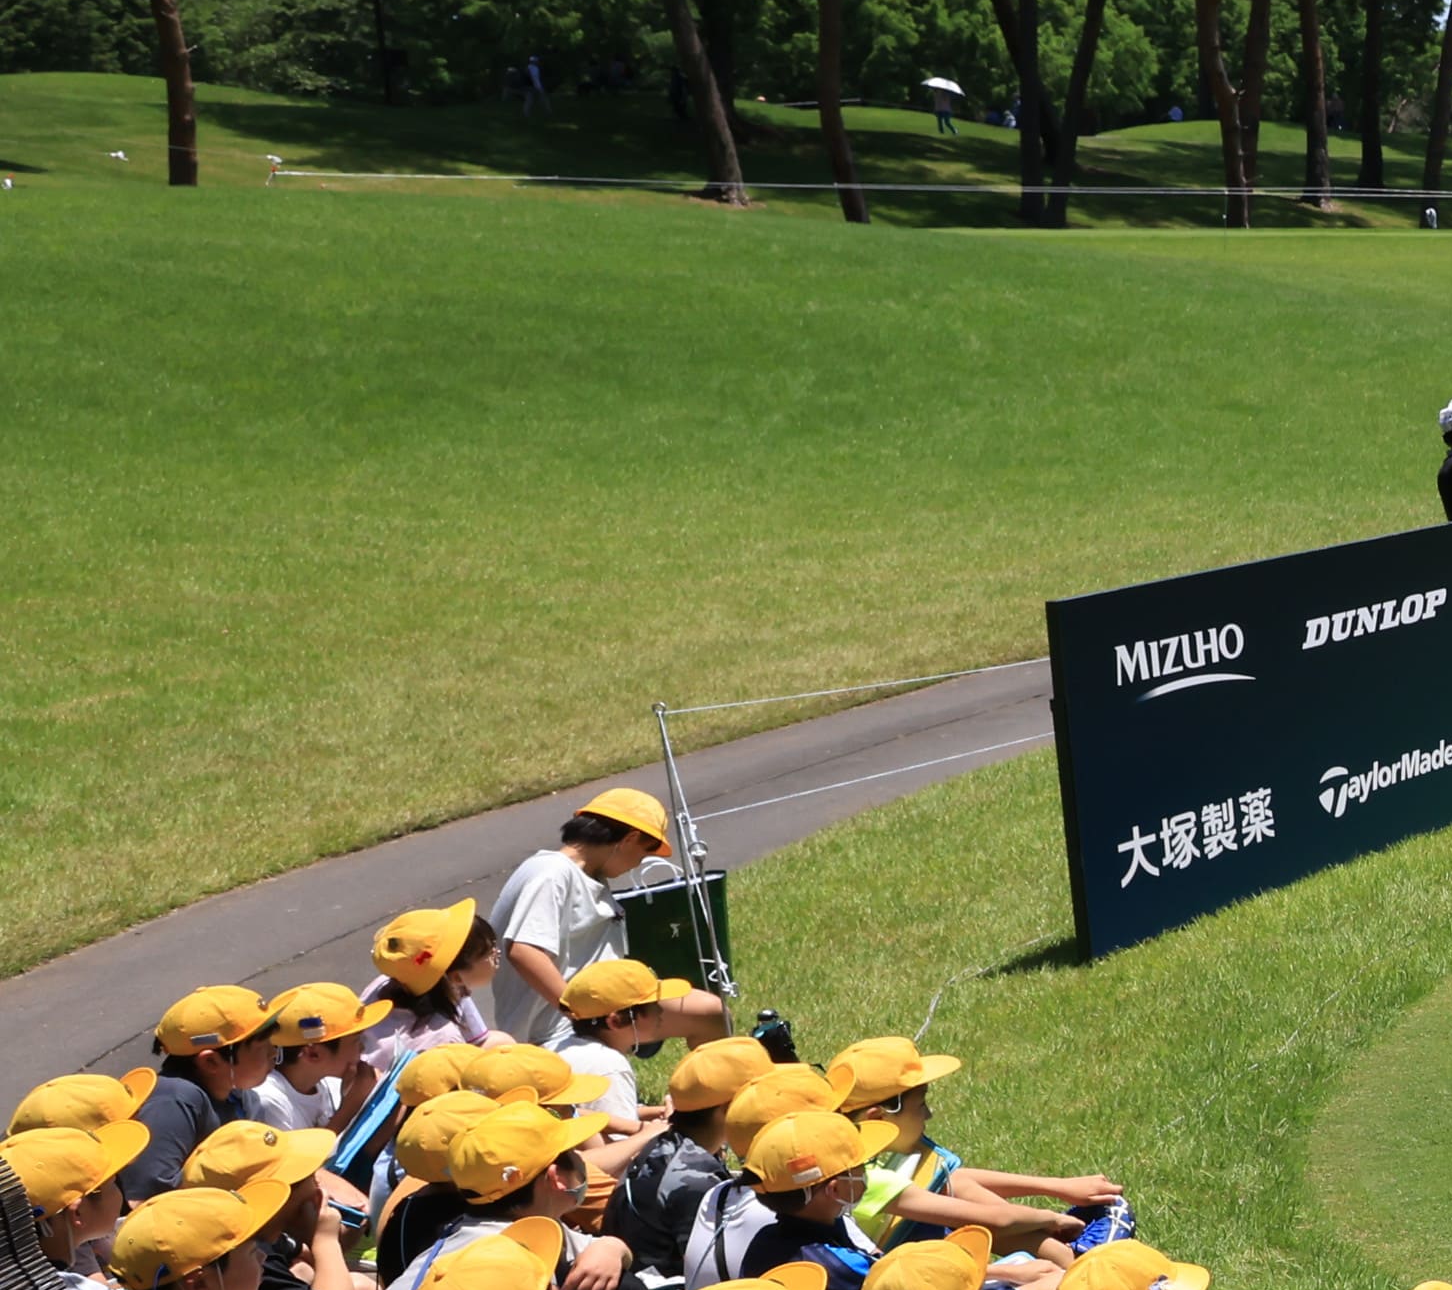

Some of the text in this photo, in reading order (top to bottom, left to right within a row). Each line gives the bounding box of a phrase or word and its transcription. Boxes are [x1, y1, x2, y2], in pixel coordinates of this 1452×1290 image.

[1302, 588, 1447, 650] DUNLOP
[1114, 623, 1246, 686] MIZUHO
[1117, 787, 1276, 889] 大塚製薬
